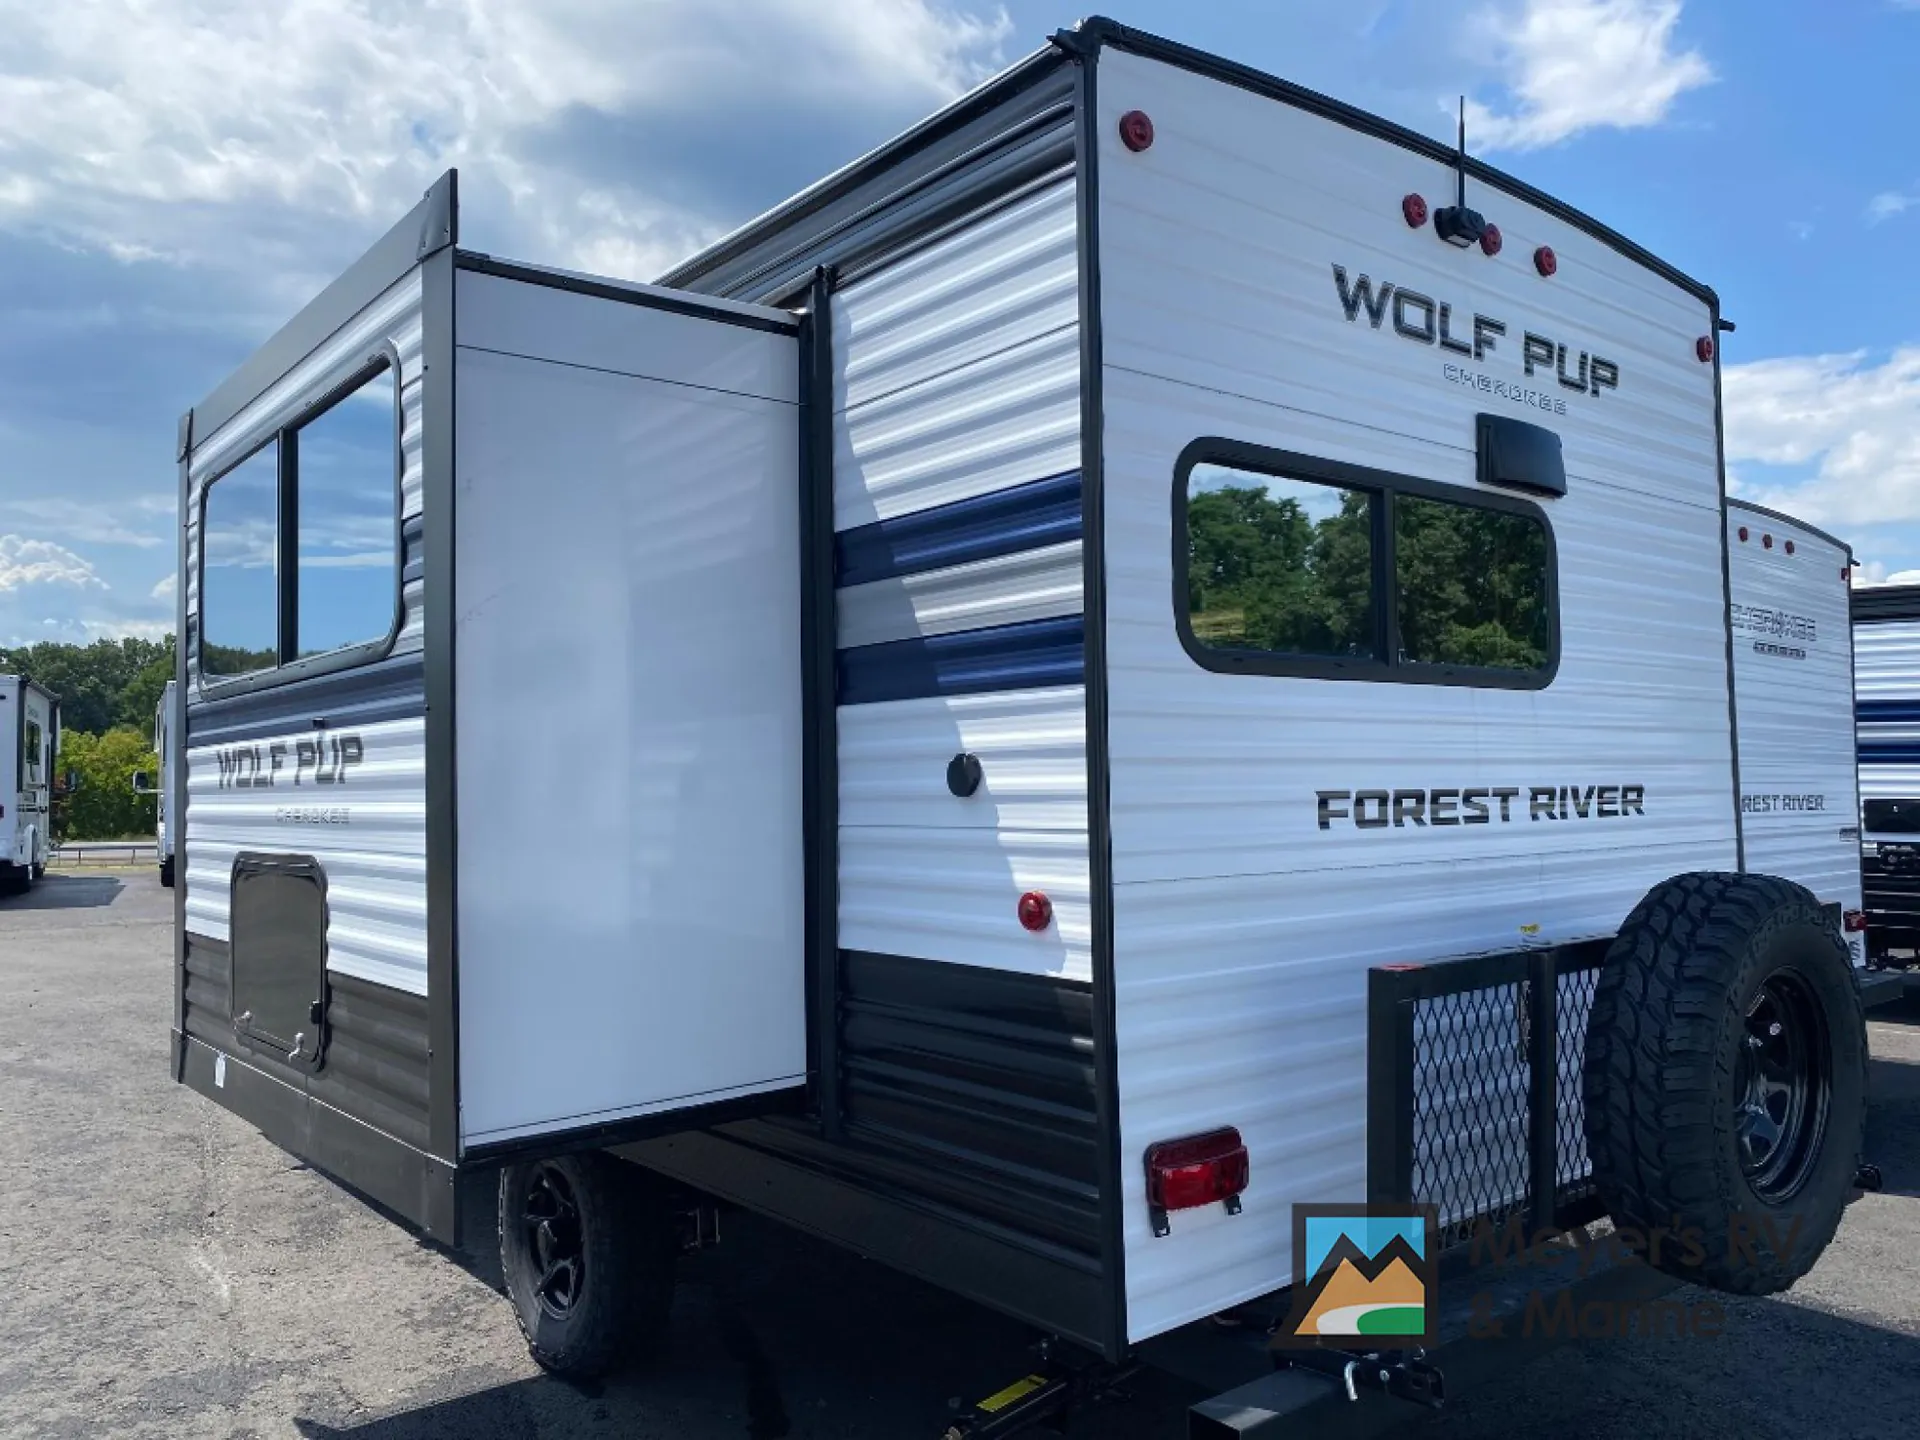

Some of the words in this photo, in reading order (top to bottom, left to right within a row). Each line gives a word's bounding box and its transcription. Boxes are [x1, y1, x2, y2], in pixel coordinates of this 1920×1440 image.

[1331, 262, 1507, 362] WOLF
[1523, 330, 1619, 398] PUP
[1443, 363, 1567, 416] CHEROKEE
[217, 741, 287, 790] WOLF
[294, 733, 363, 786] PUP
[276, 807, 350, 824] CHEROKEE
[1315, 787, 1519, 829] FOREST
[1528, 784, 1646, 821] RIVER
[1782, 794, 1826, 811] RIVER
